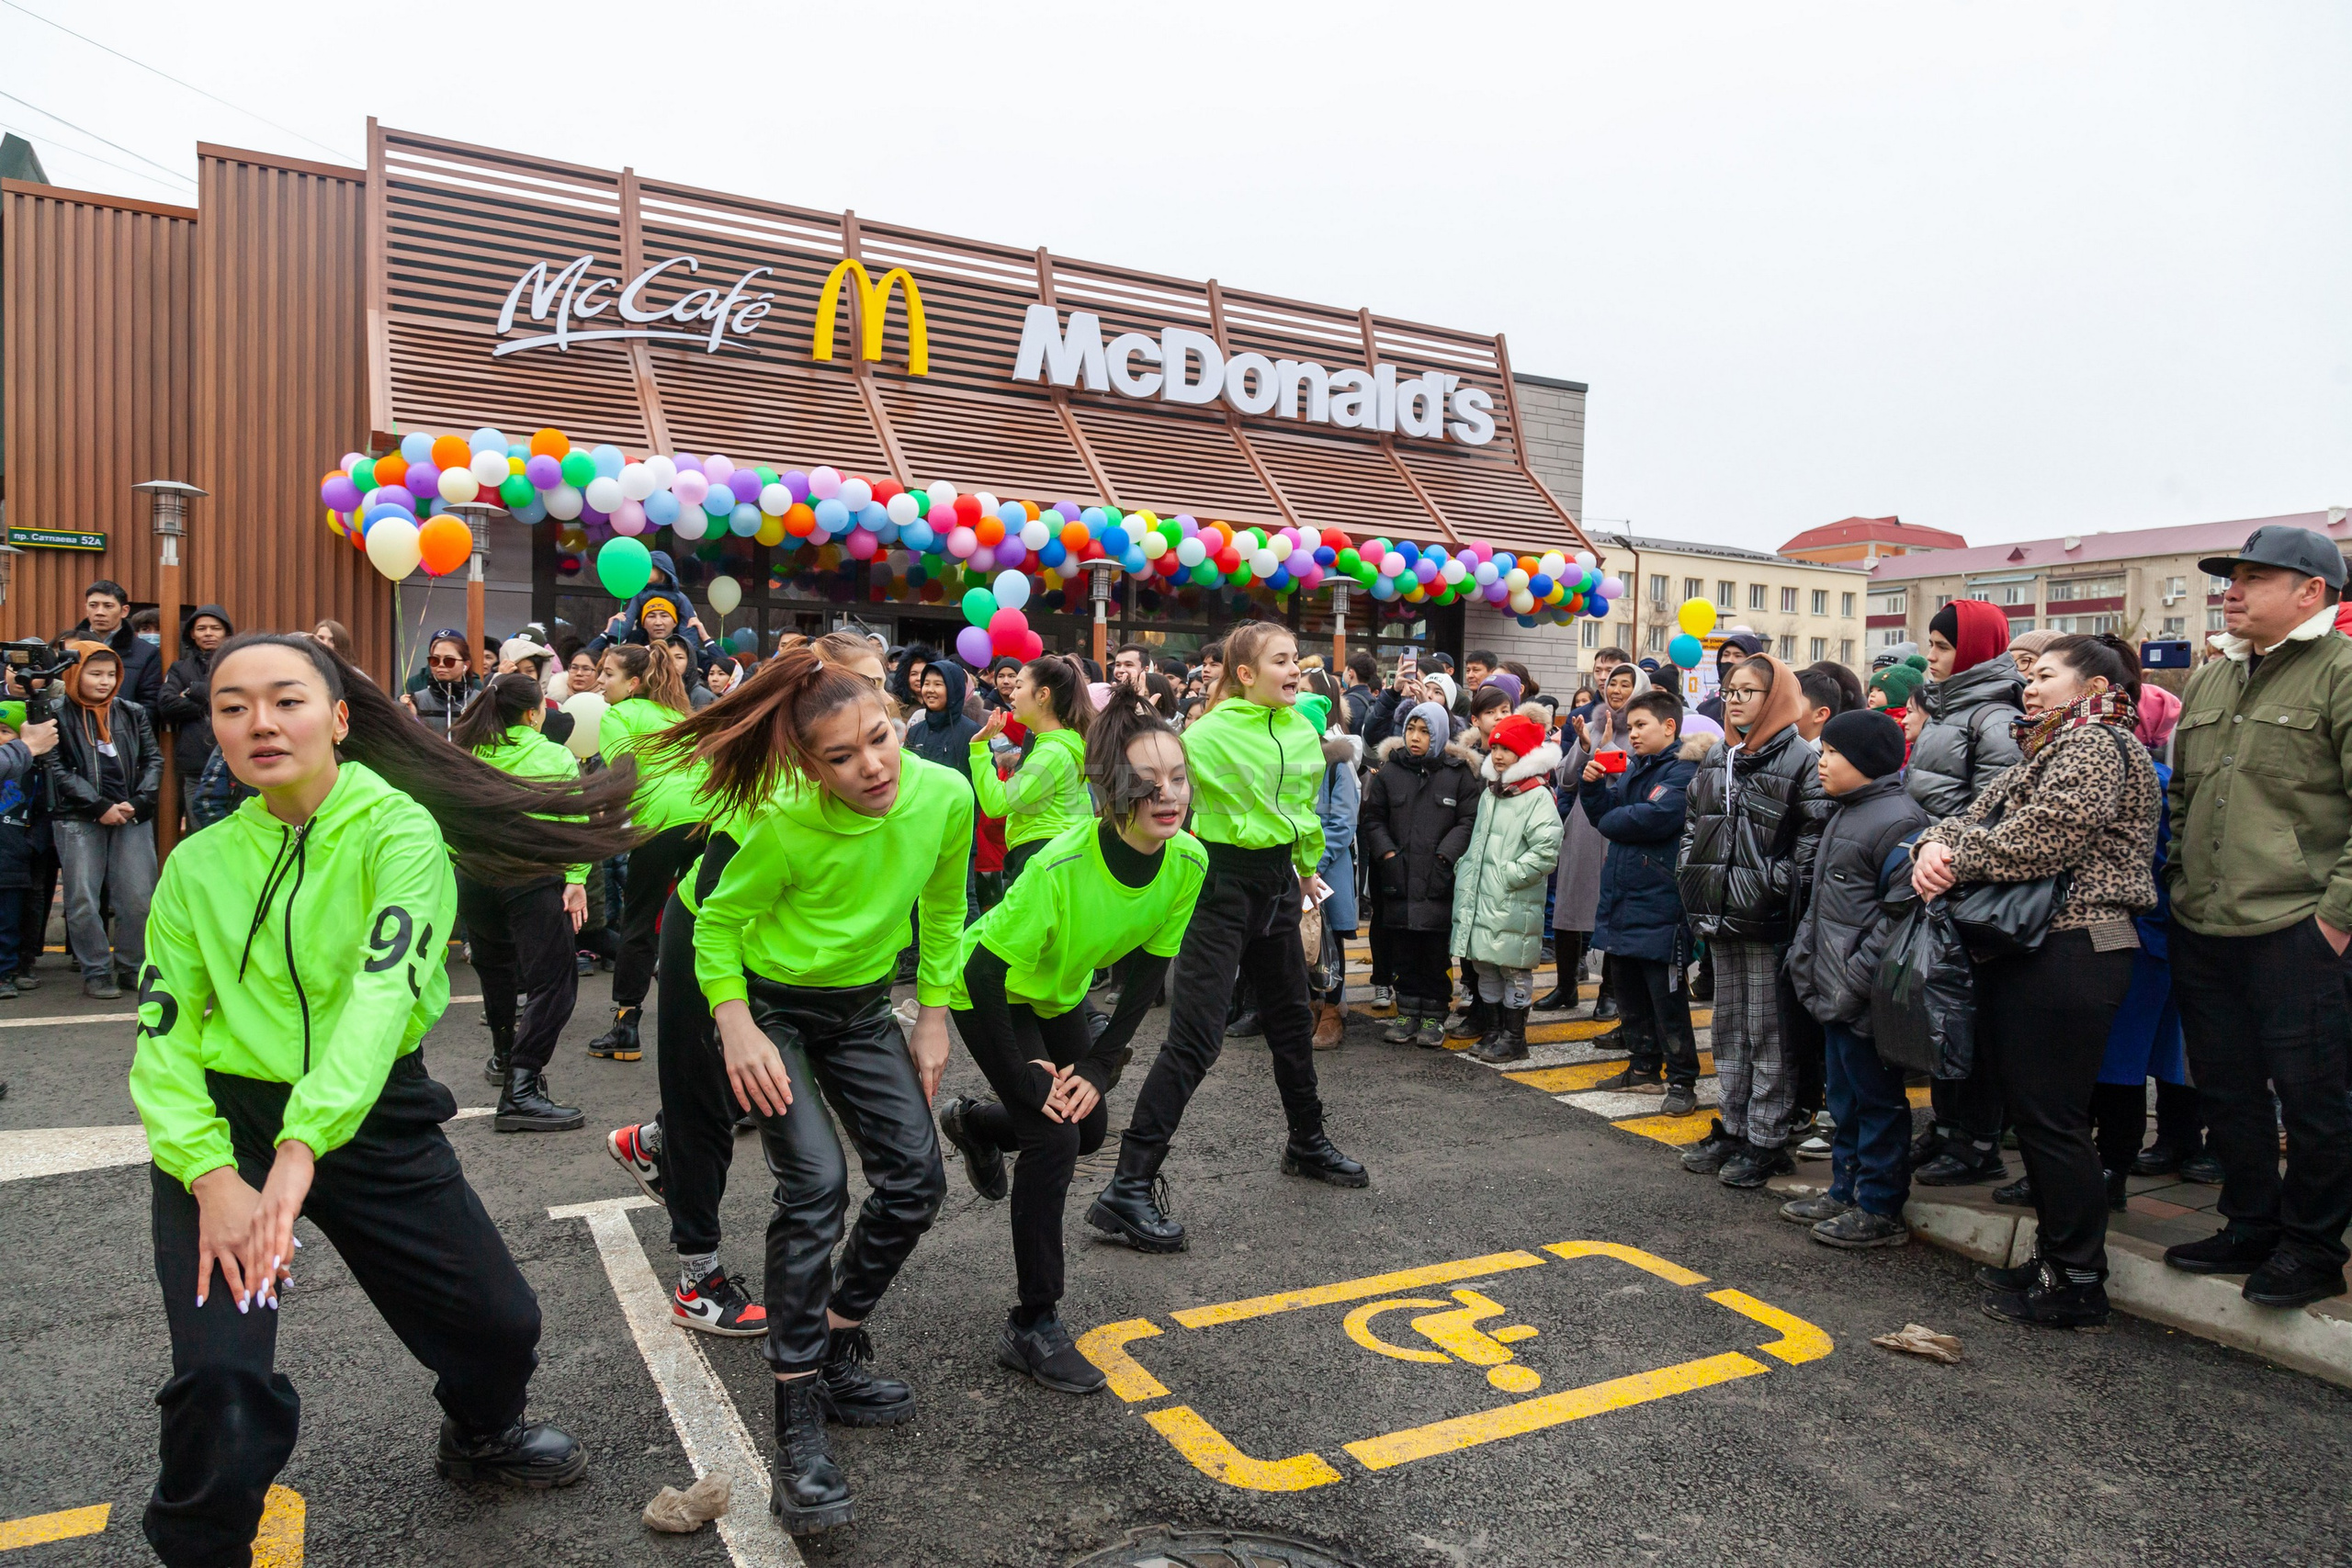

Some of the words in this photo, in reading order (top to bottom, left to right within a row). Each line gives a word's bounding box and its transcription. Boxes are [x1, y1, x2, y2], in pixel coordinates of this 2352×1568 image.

[492, 254, 775, 357] McCafé
[1012, 304, 1496, 446] McDonald's
[14, 533, 28, 541] пр.
[31, 534, 77, 544] Сатпаева
